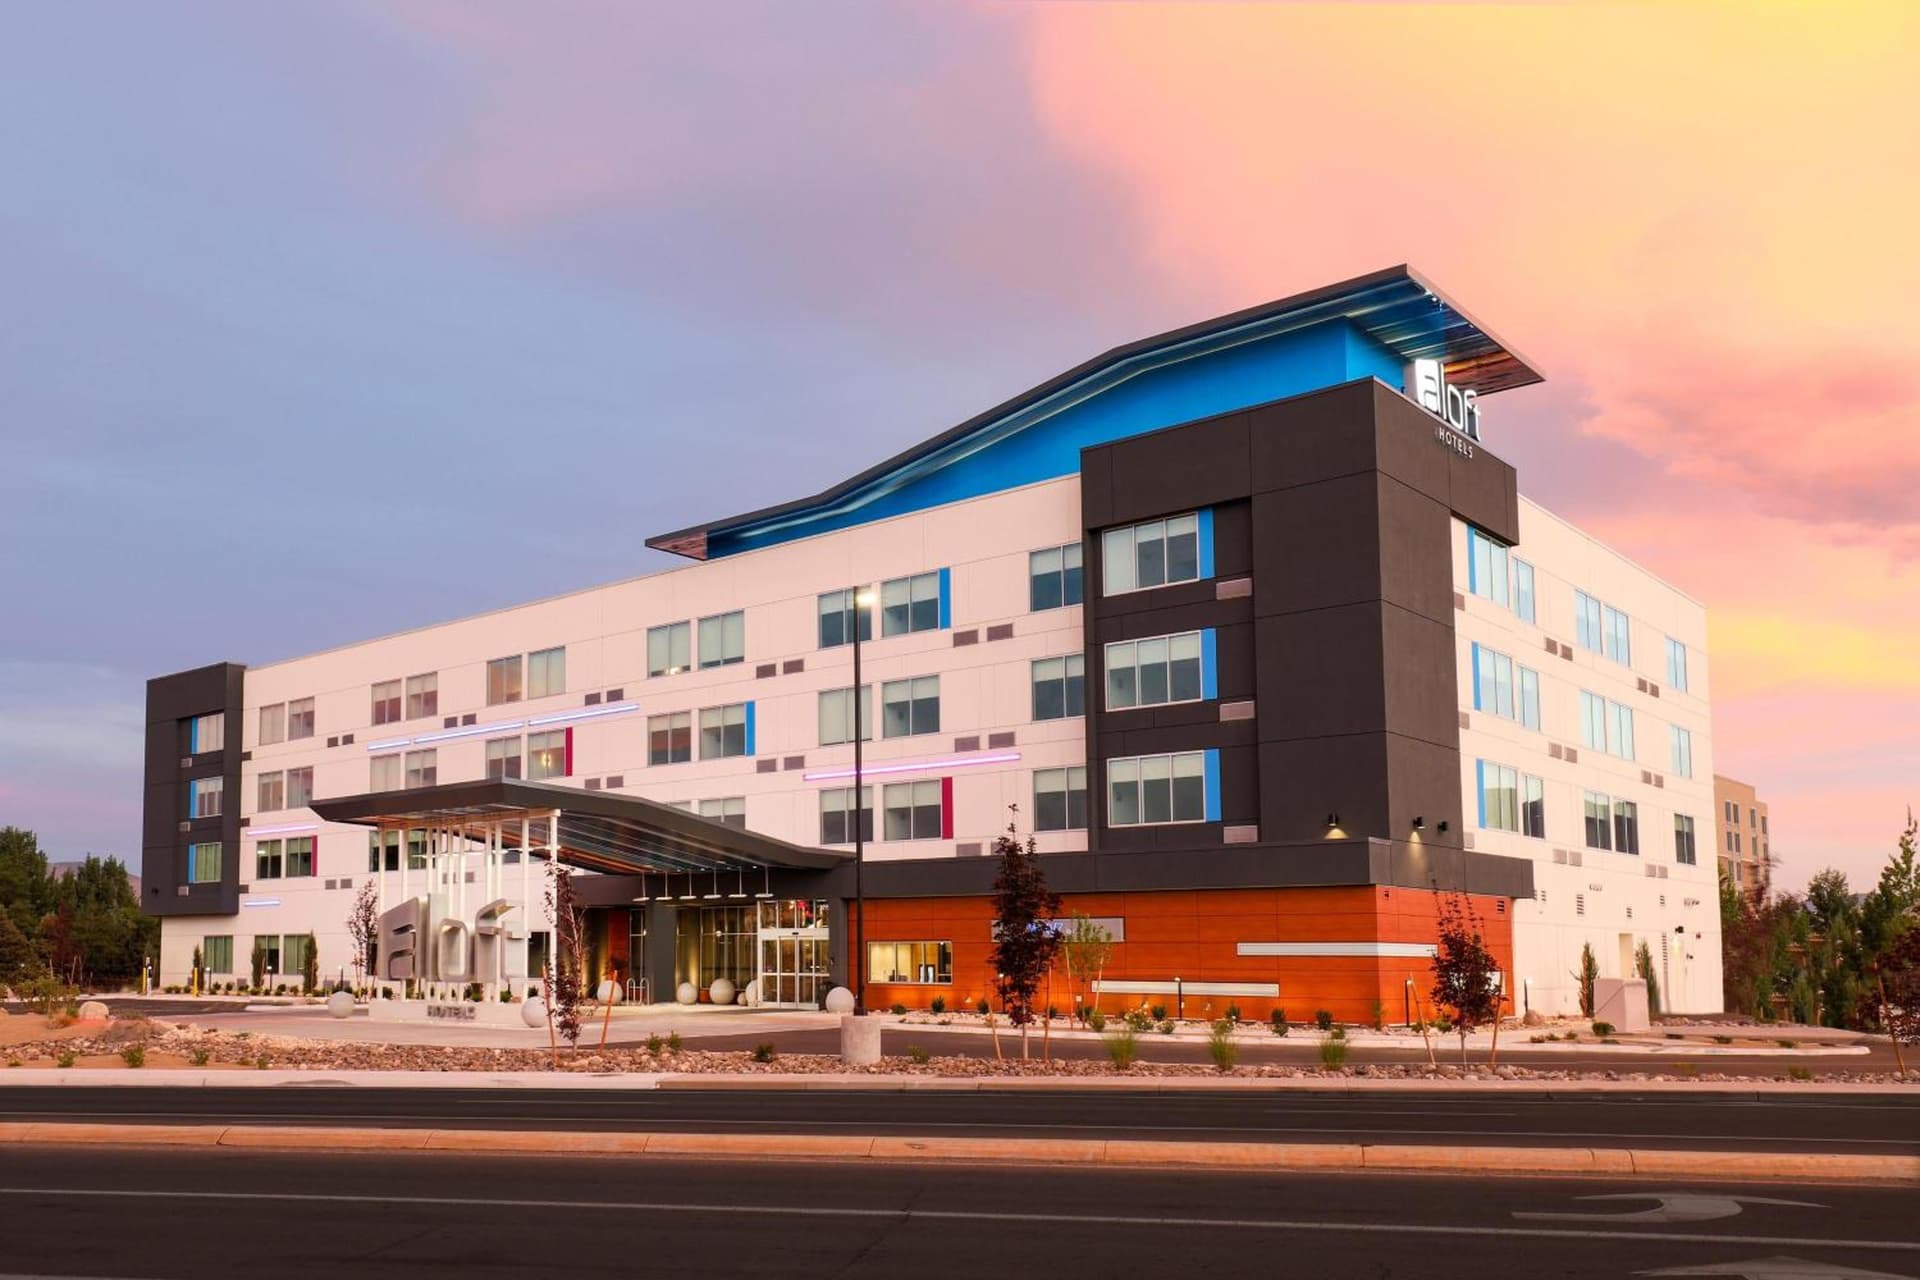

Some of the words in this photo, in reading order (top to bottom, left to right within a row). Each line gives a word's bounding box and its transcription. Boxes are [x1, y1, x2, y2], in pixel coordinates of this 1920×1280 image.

[1415, 358, 1481, 442] aloft
[1439, 427, 1473, 459] HOTELS
[377, 893, 525, 984] aloft
